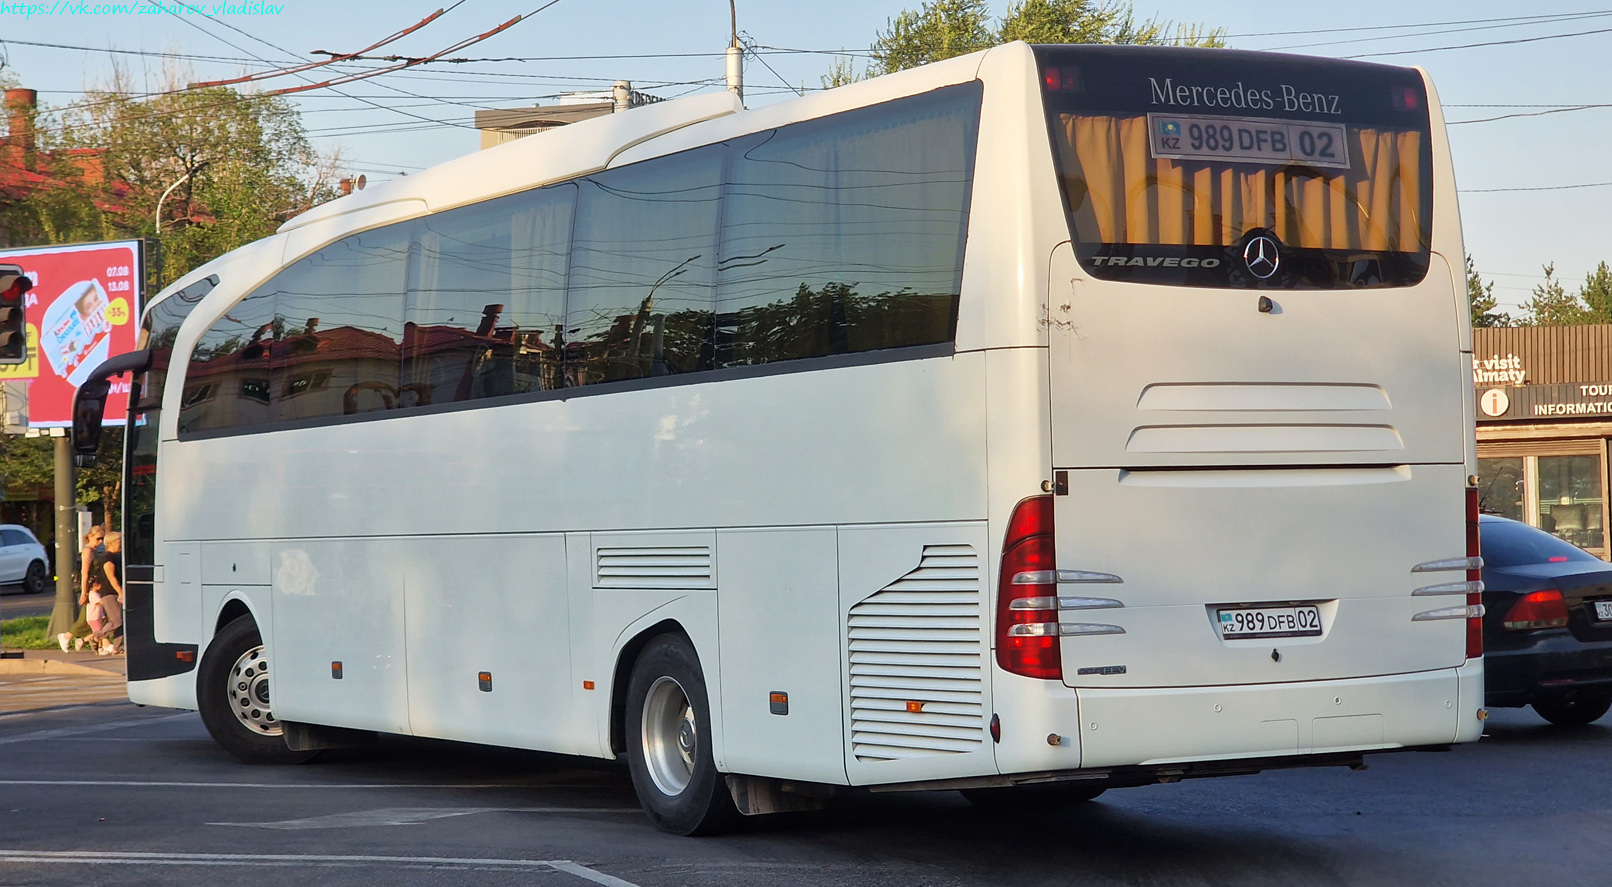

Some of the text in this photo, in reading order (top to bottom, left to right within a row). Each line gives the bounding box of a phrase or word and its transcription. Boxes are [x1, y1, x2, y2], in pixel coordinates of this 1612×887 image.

[1149, 77, 1342, 115] Mercedes-Benz
[1161, 123, 1336, 159] KZ 989 DFB 02
[1091, 256, 1220, 268] TRAVEGO
[1483, 353, 1521, 370] visit
[1223, 609, 1319, 632] KZ 989 DFB 02
